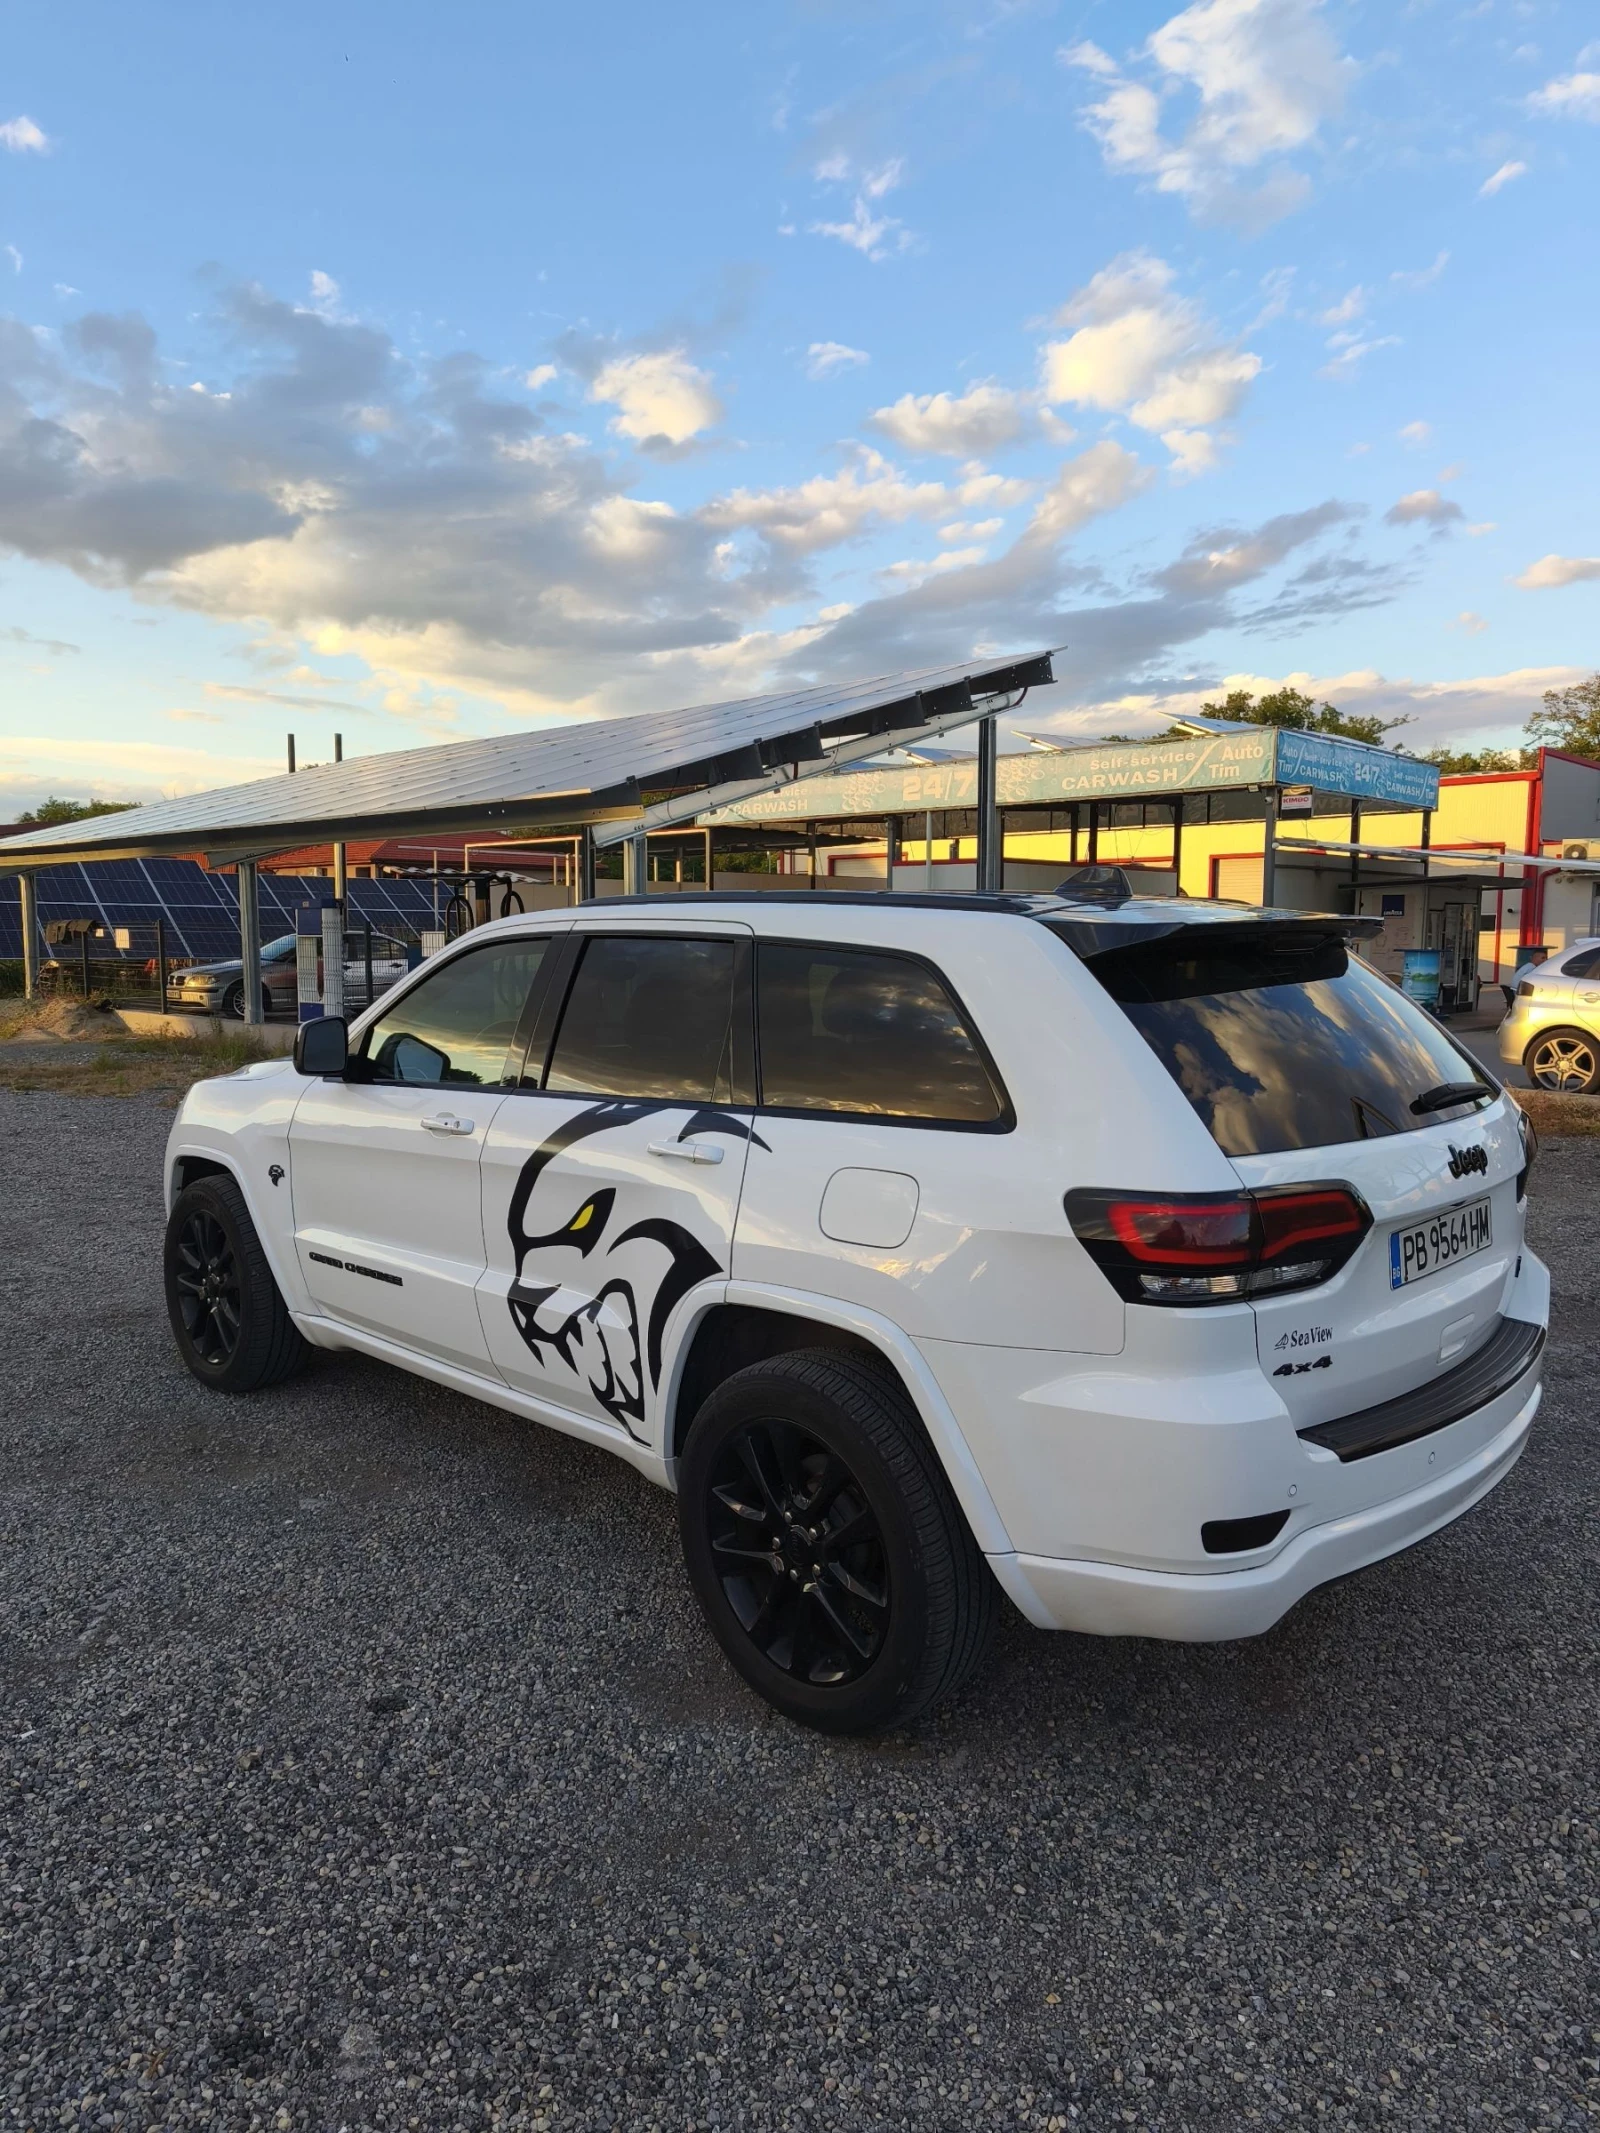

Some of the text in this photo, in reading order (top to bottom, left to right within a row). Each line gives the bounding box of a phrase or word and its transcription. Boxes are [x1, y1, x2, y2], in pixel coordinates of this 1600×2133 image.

[1221, 745, 1264, 762] Auto
[1282, 742, 1298, 758] Auto
[1089, 752, 1197, 770] Self-service
[1278, 759, 1293, 774] Tim
[1061, 768, 1178, 790] CARWASH
[1208, 763, 1240, 779] Tim
[1300, 765, 1343, 783] CARWASH
[903, 770, 974, 801] 24/7
[1386, 780, 1420, 797] CARWASH
[733, 799, 808, 815] CARWASH
[1447, 1144, 1488, 1179] Jeep
[1403, 1205, 1489, 1276] PB 9564 HM
[1272, 1354, 1333, 1376] 4x4
